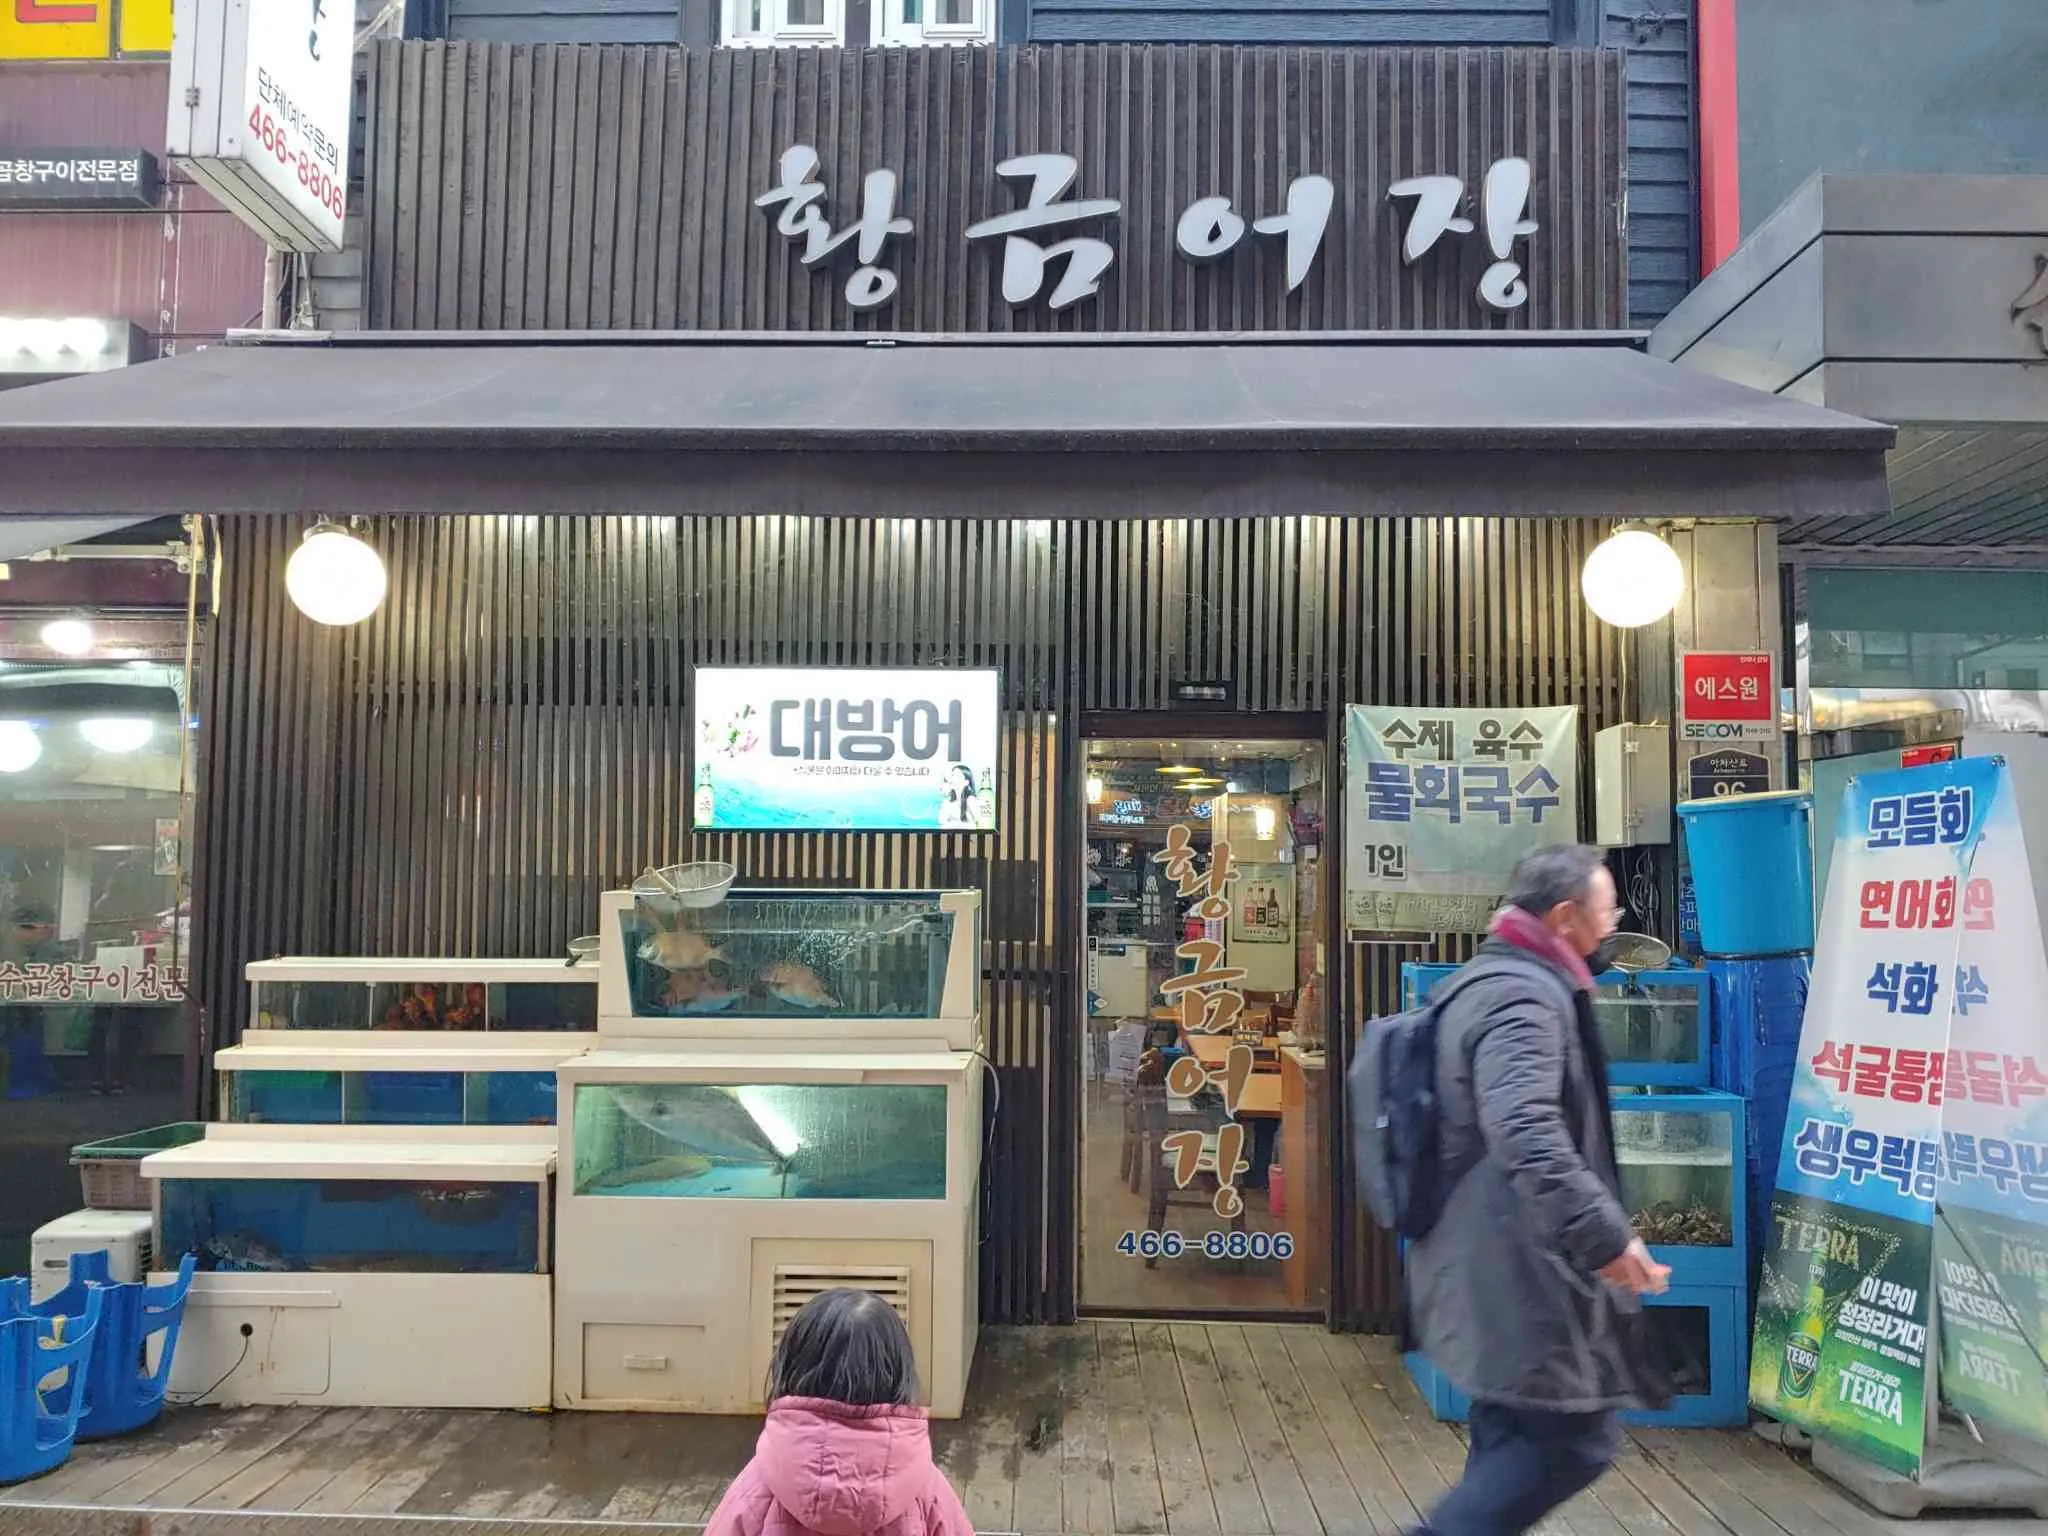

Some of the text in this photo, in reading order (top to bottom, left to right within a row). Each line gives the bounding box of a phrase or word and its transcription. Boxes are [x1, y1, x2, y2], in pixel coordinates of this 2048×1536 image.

[249, 104, 343, 220] 466-8806
[755, 146, 1538, 310] 황금어장
[1694, 677, 1759, 701] 에스원
[770, 698, 962, 761] 대방어
[1382, 718, 1543, 761] 수제 육수
[1685, 723, 1743, 738] SECOM
[1365, 762, 1560, 825] 물회국수
[1365, 844, 1405, 878] 1인
[1860, 875, 1957, 929] 연어회
[1866, 961, 1939, 1015] 석화
[1116, 1231, 1295, 1260] 466-8806
[1776, 1216, 1861, 1272] TERRA
[1860, 1276, 1918, 1316] 이 맛이
[1786, 1344, 1818, 1372] TERRA
[1839, 1368, 1903, 1426] TERRA
